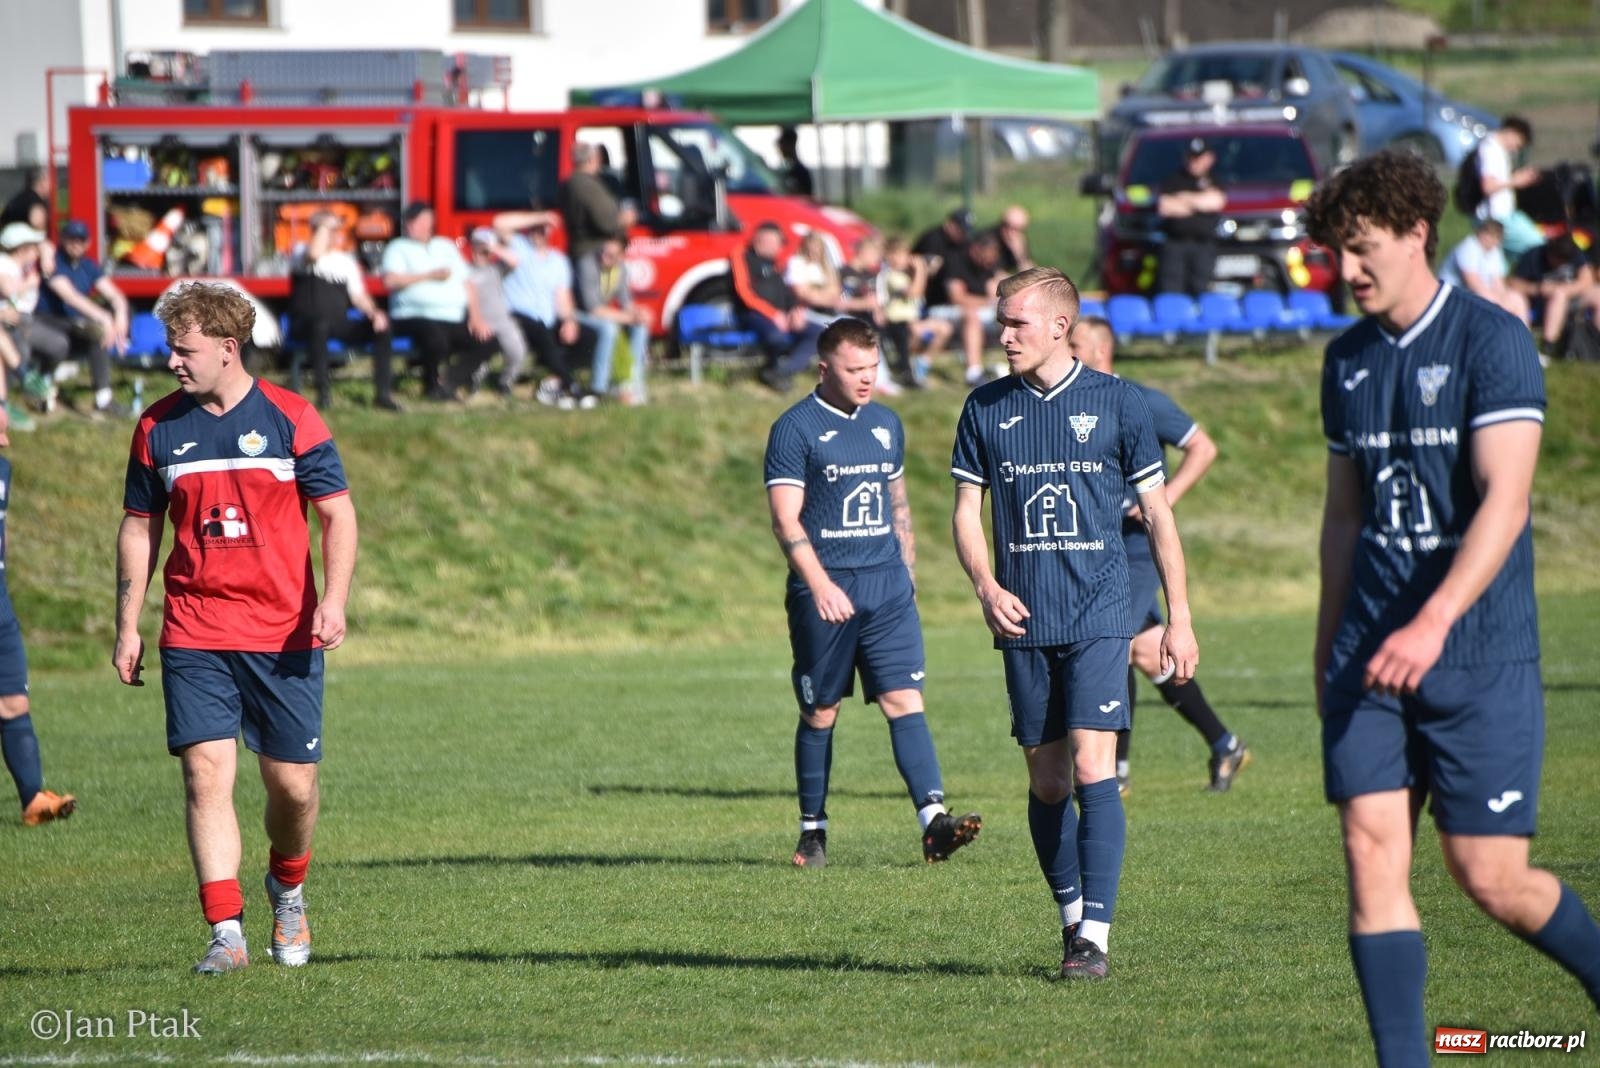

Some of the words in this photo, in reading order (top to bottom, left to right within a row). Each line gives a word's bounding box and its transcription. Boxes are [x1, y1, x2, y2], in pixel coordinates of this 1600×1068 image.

[839, 464, 879, 475] MASTER
[1015, 462, 1066, 475] MASTER
[1070, 461, 1103, 473] GSM
[821, 528, 868, 538] Bauservice
[1058, 539, 1104, 551] Lisowski
